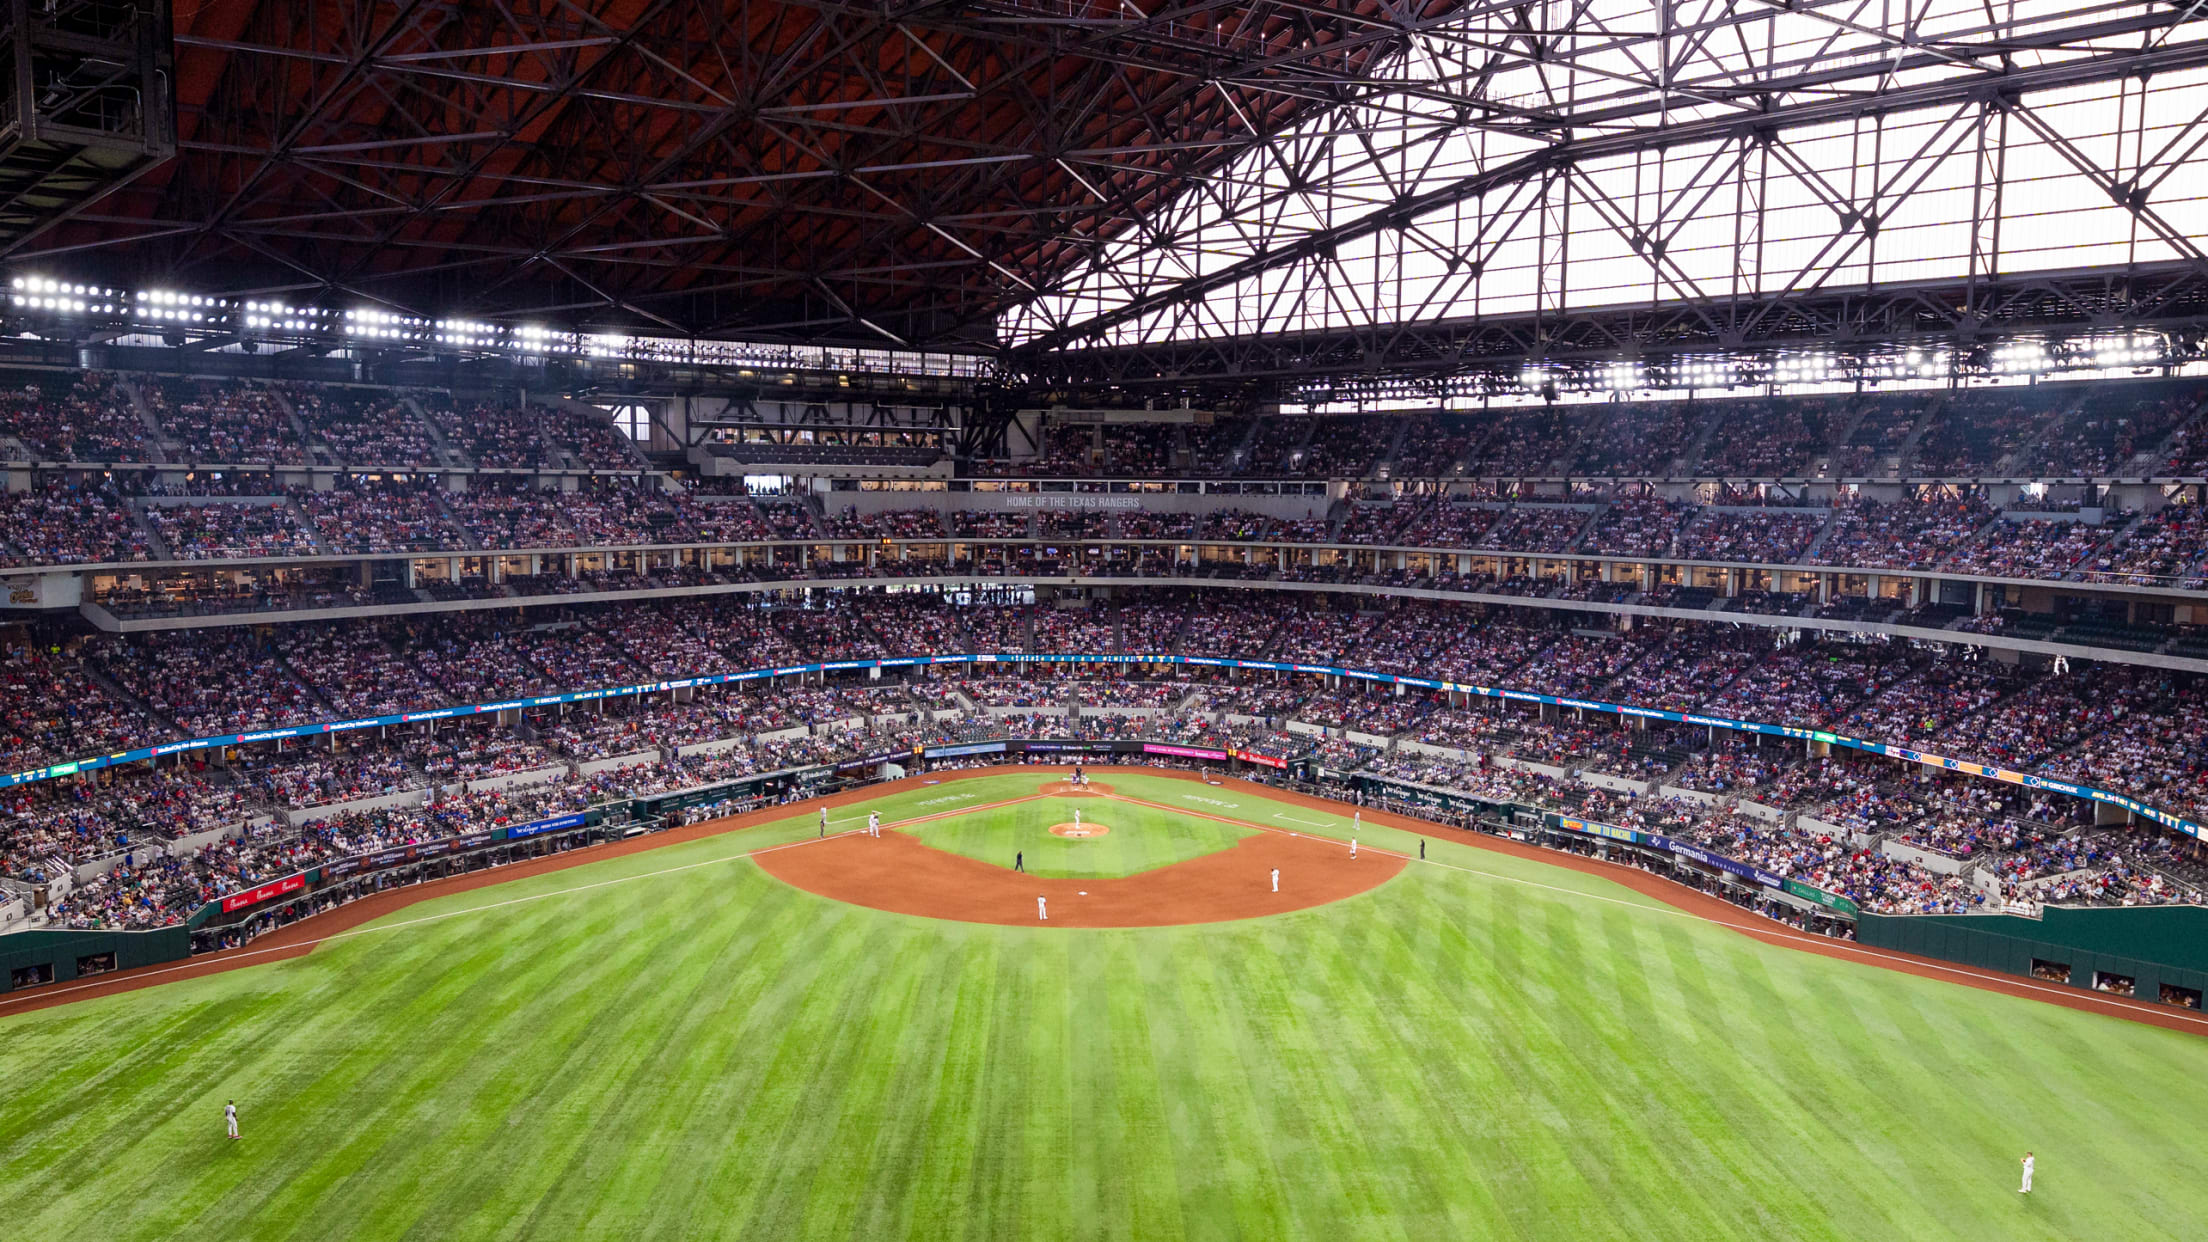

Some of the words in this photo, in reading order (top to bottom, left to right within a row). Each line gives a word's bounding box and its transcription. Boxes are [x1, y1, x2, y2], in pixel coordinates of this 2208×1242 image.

[1007, 497, 1032, 506] HOME
[1035, 497, 1047, 506] OF
[1050, 497, 1065, 506] THE
[1069, 497, 1096, 507] TEXAS
[1099, 497, 1139, 507] RANGERS
[1668, 841, 1708, 862] Germania
[1708, 859, 1744, 876] INSURANCE
